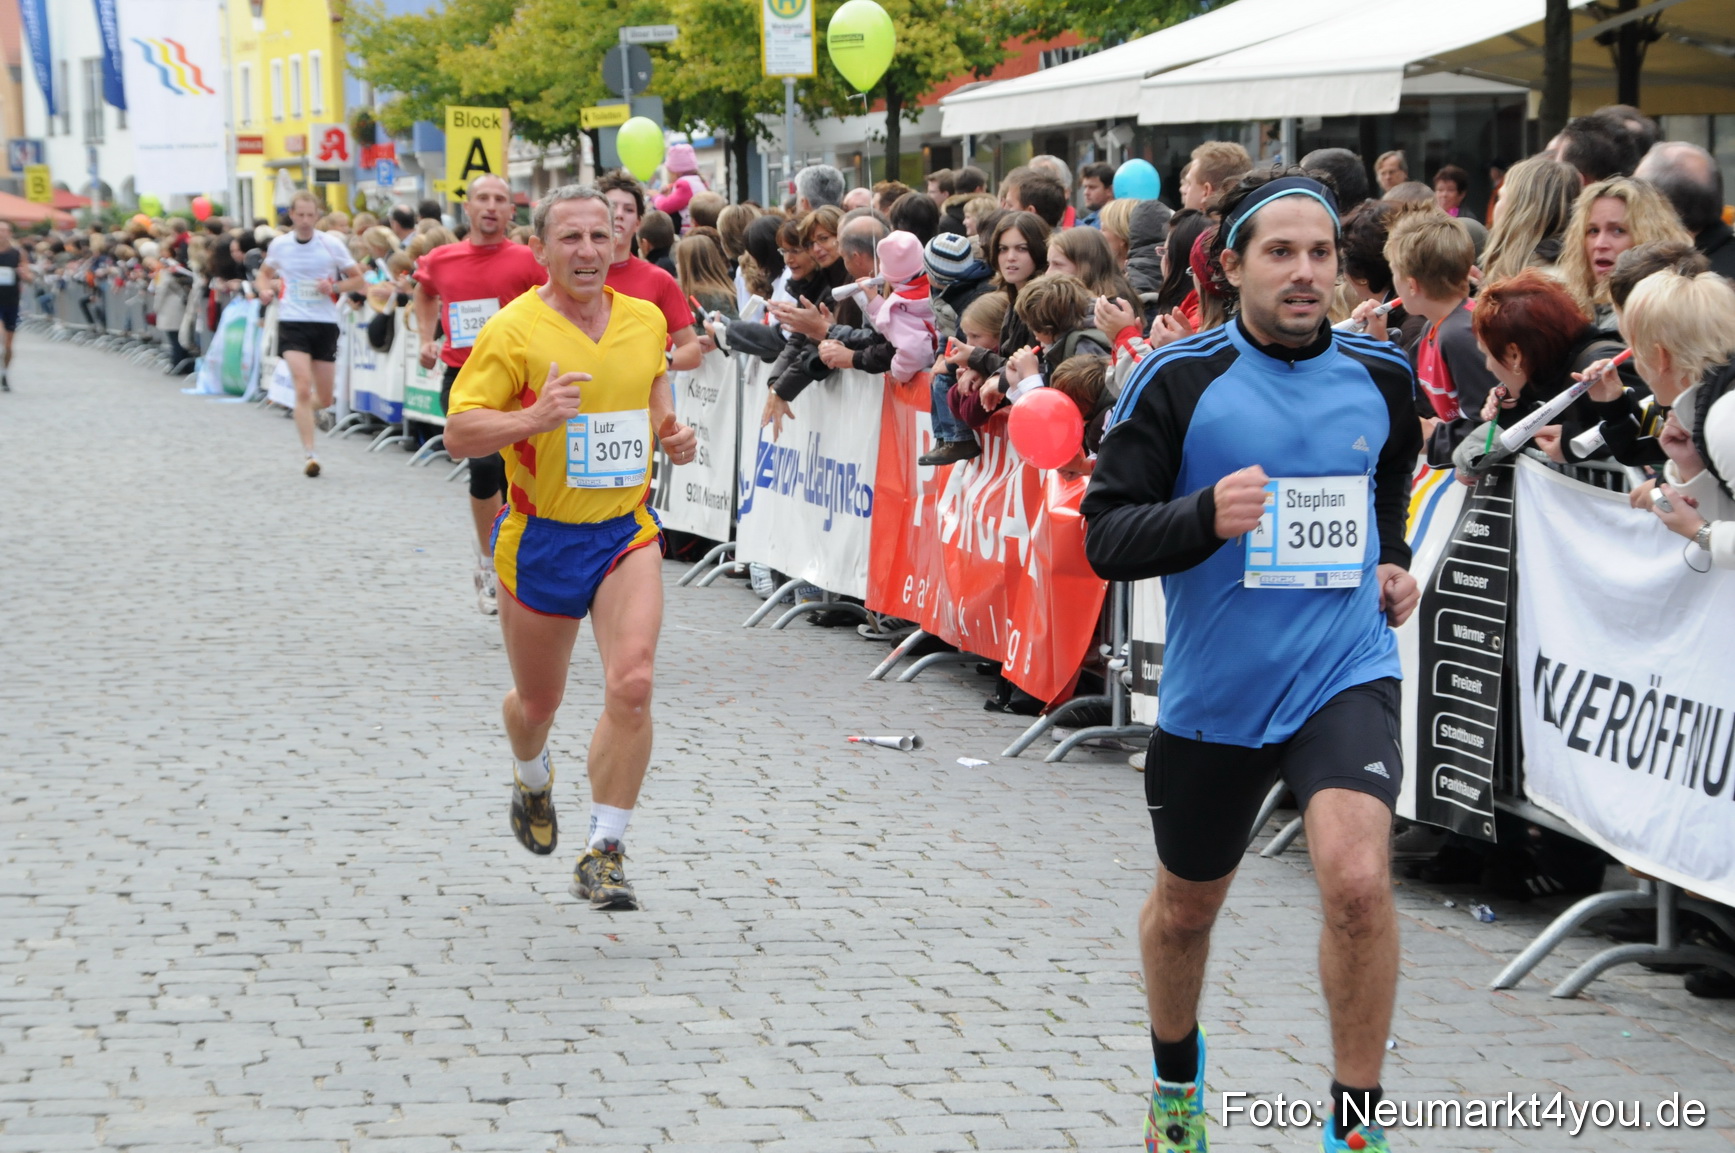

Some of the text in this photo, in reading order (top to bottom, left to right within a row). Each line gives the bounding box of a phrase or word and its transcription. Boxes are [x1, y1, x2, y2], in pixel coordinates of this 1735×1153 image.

[454, 111, 501, 129] Block
[460, 136, 492, 180] A
[463, 315, 492, 330] 328
[594, 421, 615, 433] Lutz
[574, 442, 579, 452] A
[595, 439, 643, 461] 3079
[1286, 488, 1345, 511] Stephan
[1288, 519, 1358, 549] 3088
[1452, 570, 1489, 589] Wasser
[1453, 623, 1485, 644] Wärme
[1451, 673, 1483, 695] Freizeit
[1440, 723, 1485, 749] Stadtbusse
[1439, 774, 1481, 801] Parkhäuser
